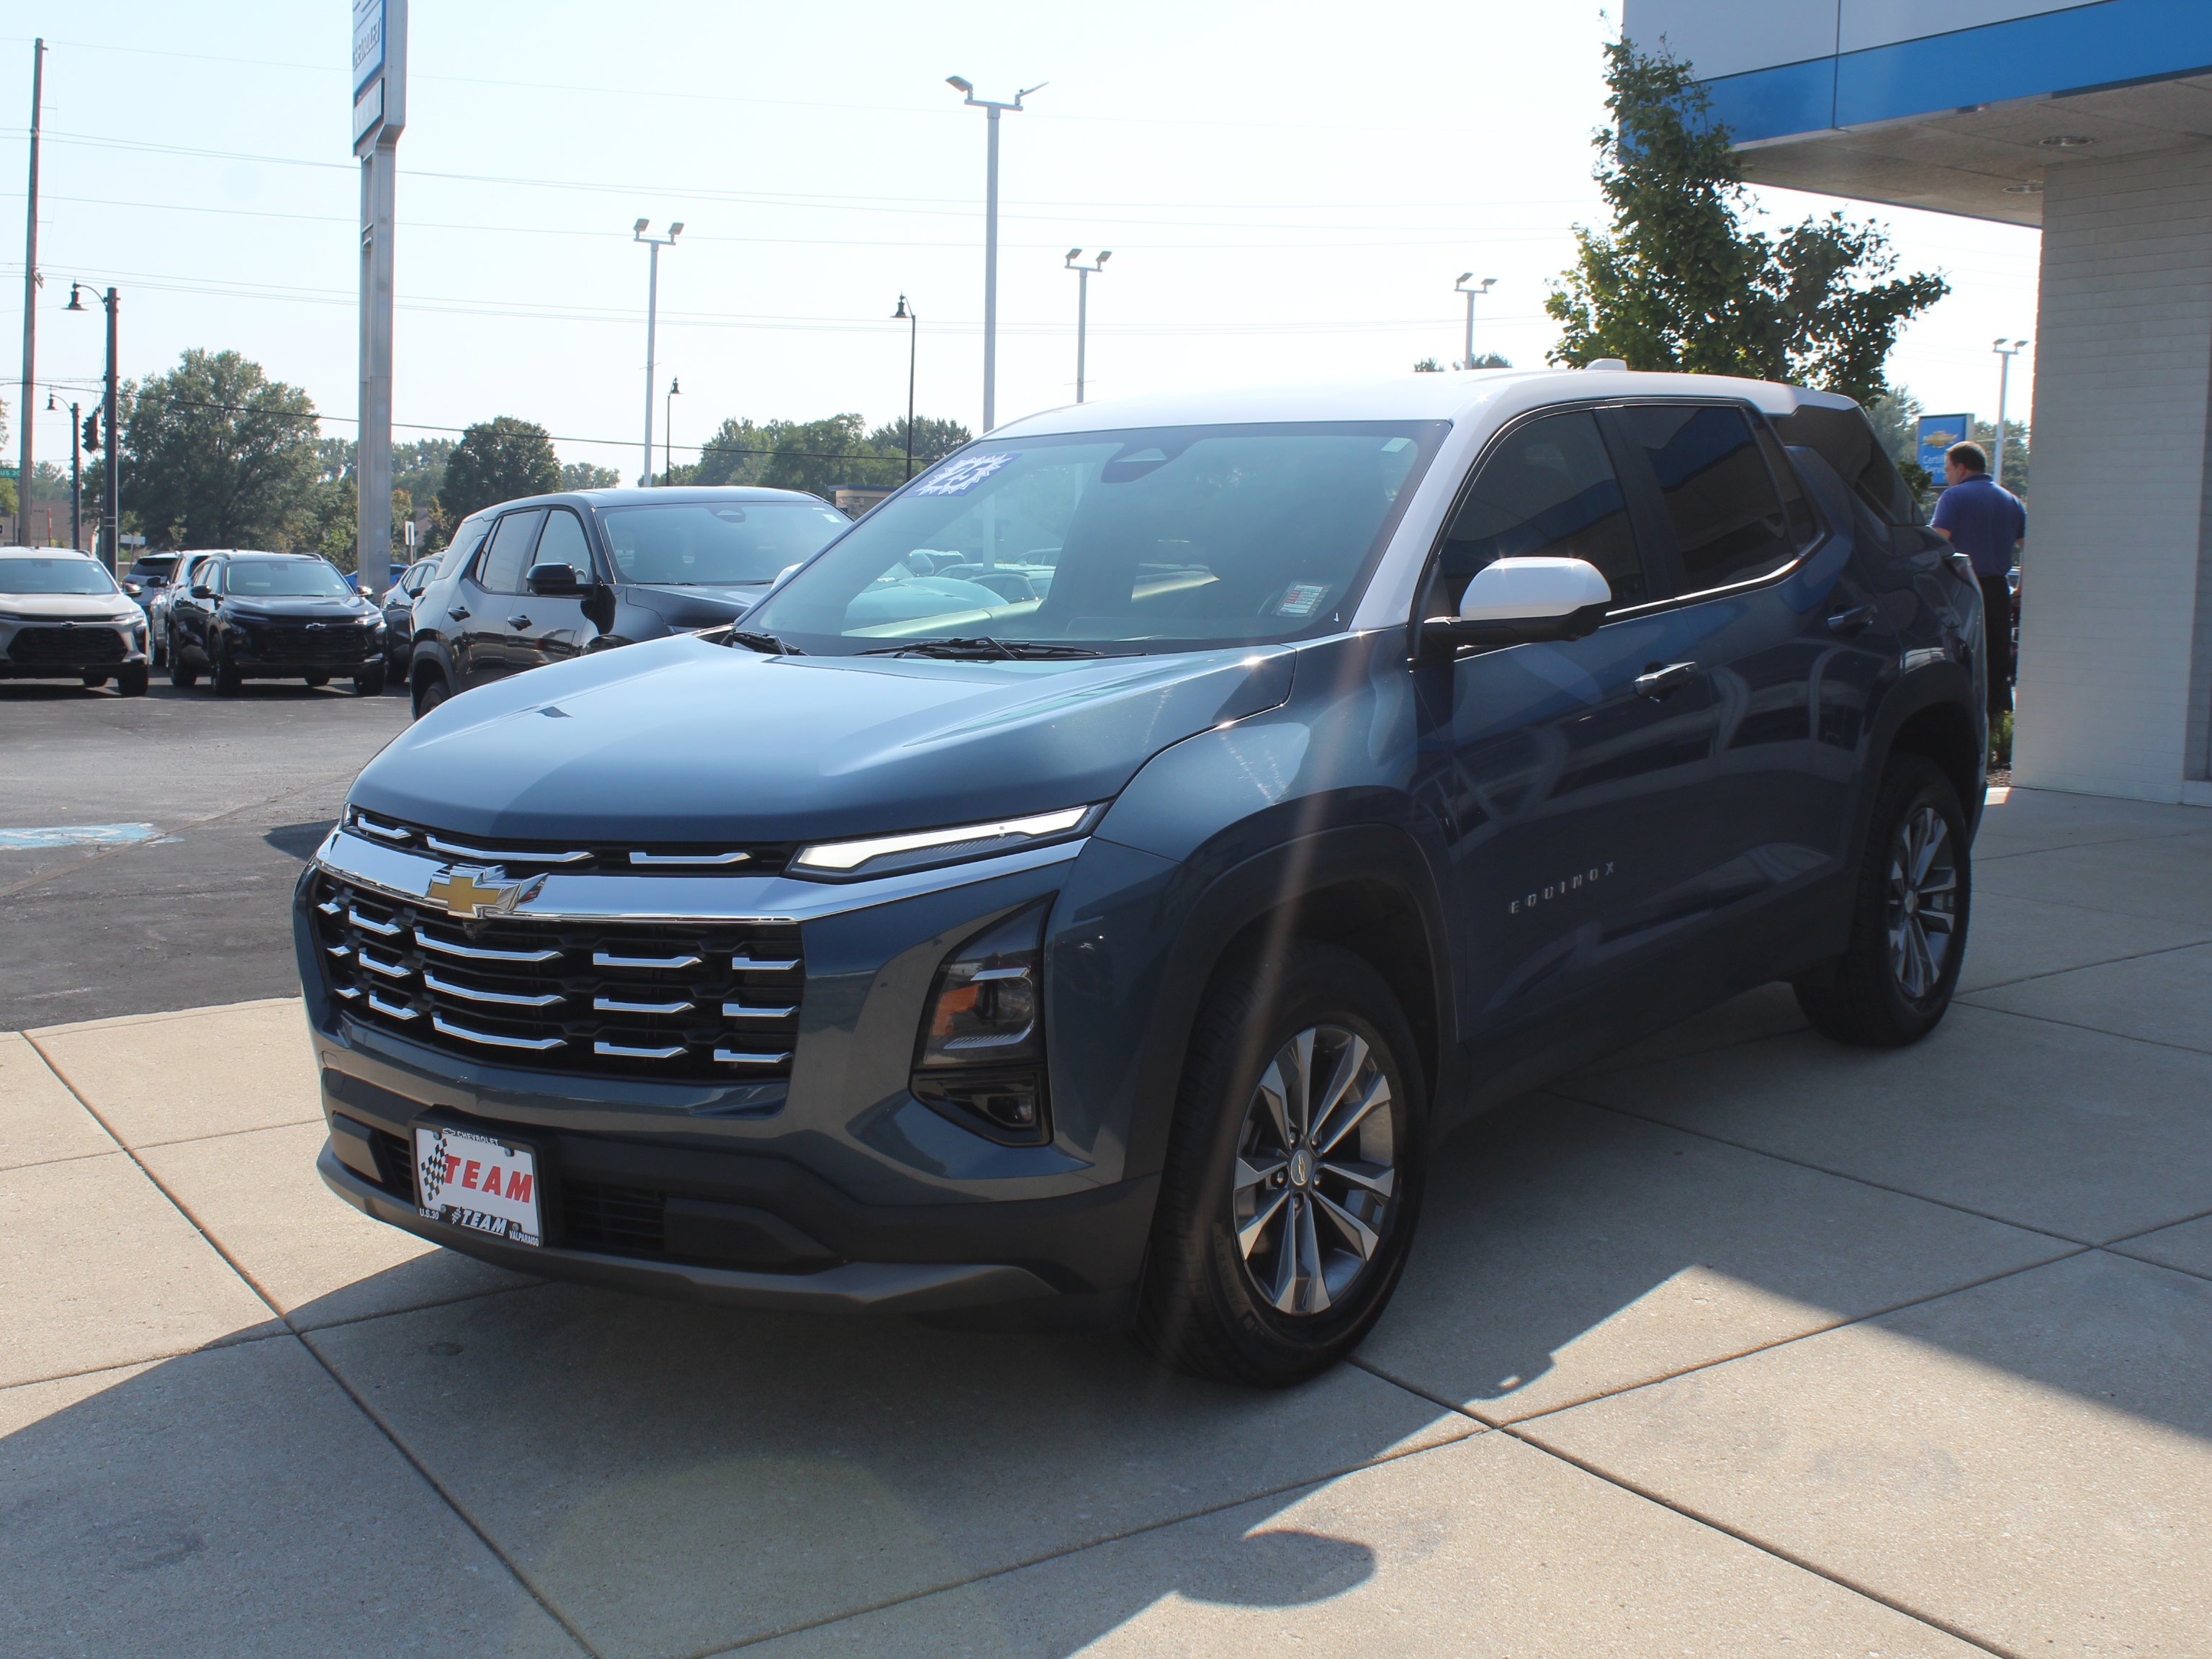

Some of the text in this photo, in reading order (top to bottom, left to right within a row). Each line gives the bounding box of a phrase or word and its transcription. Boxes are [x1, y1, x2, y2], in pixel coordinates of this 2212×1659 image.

[1509, 861, 1614, 914] EQUINOX
[457, 1130, 499, 1146] CHEVROLET
[444, 1154, 533, 1204] TEAM
[419, 1208, 439, 1220] U.S.30
[462, 1208, 508, 1234] TEAM
[509, 1230, 540, 1247] VALPARAISO
